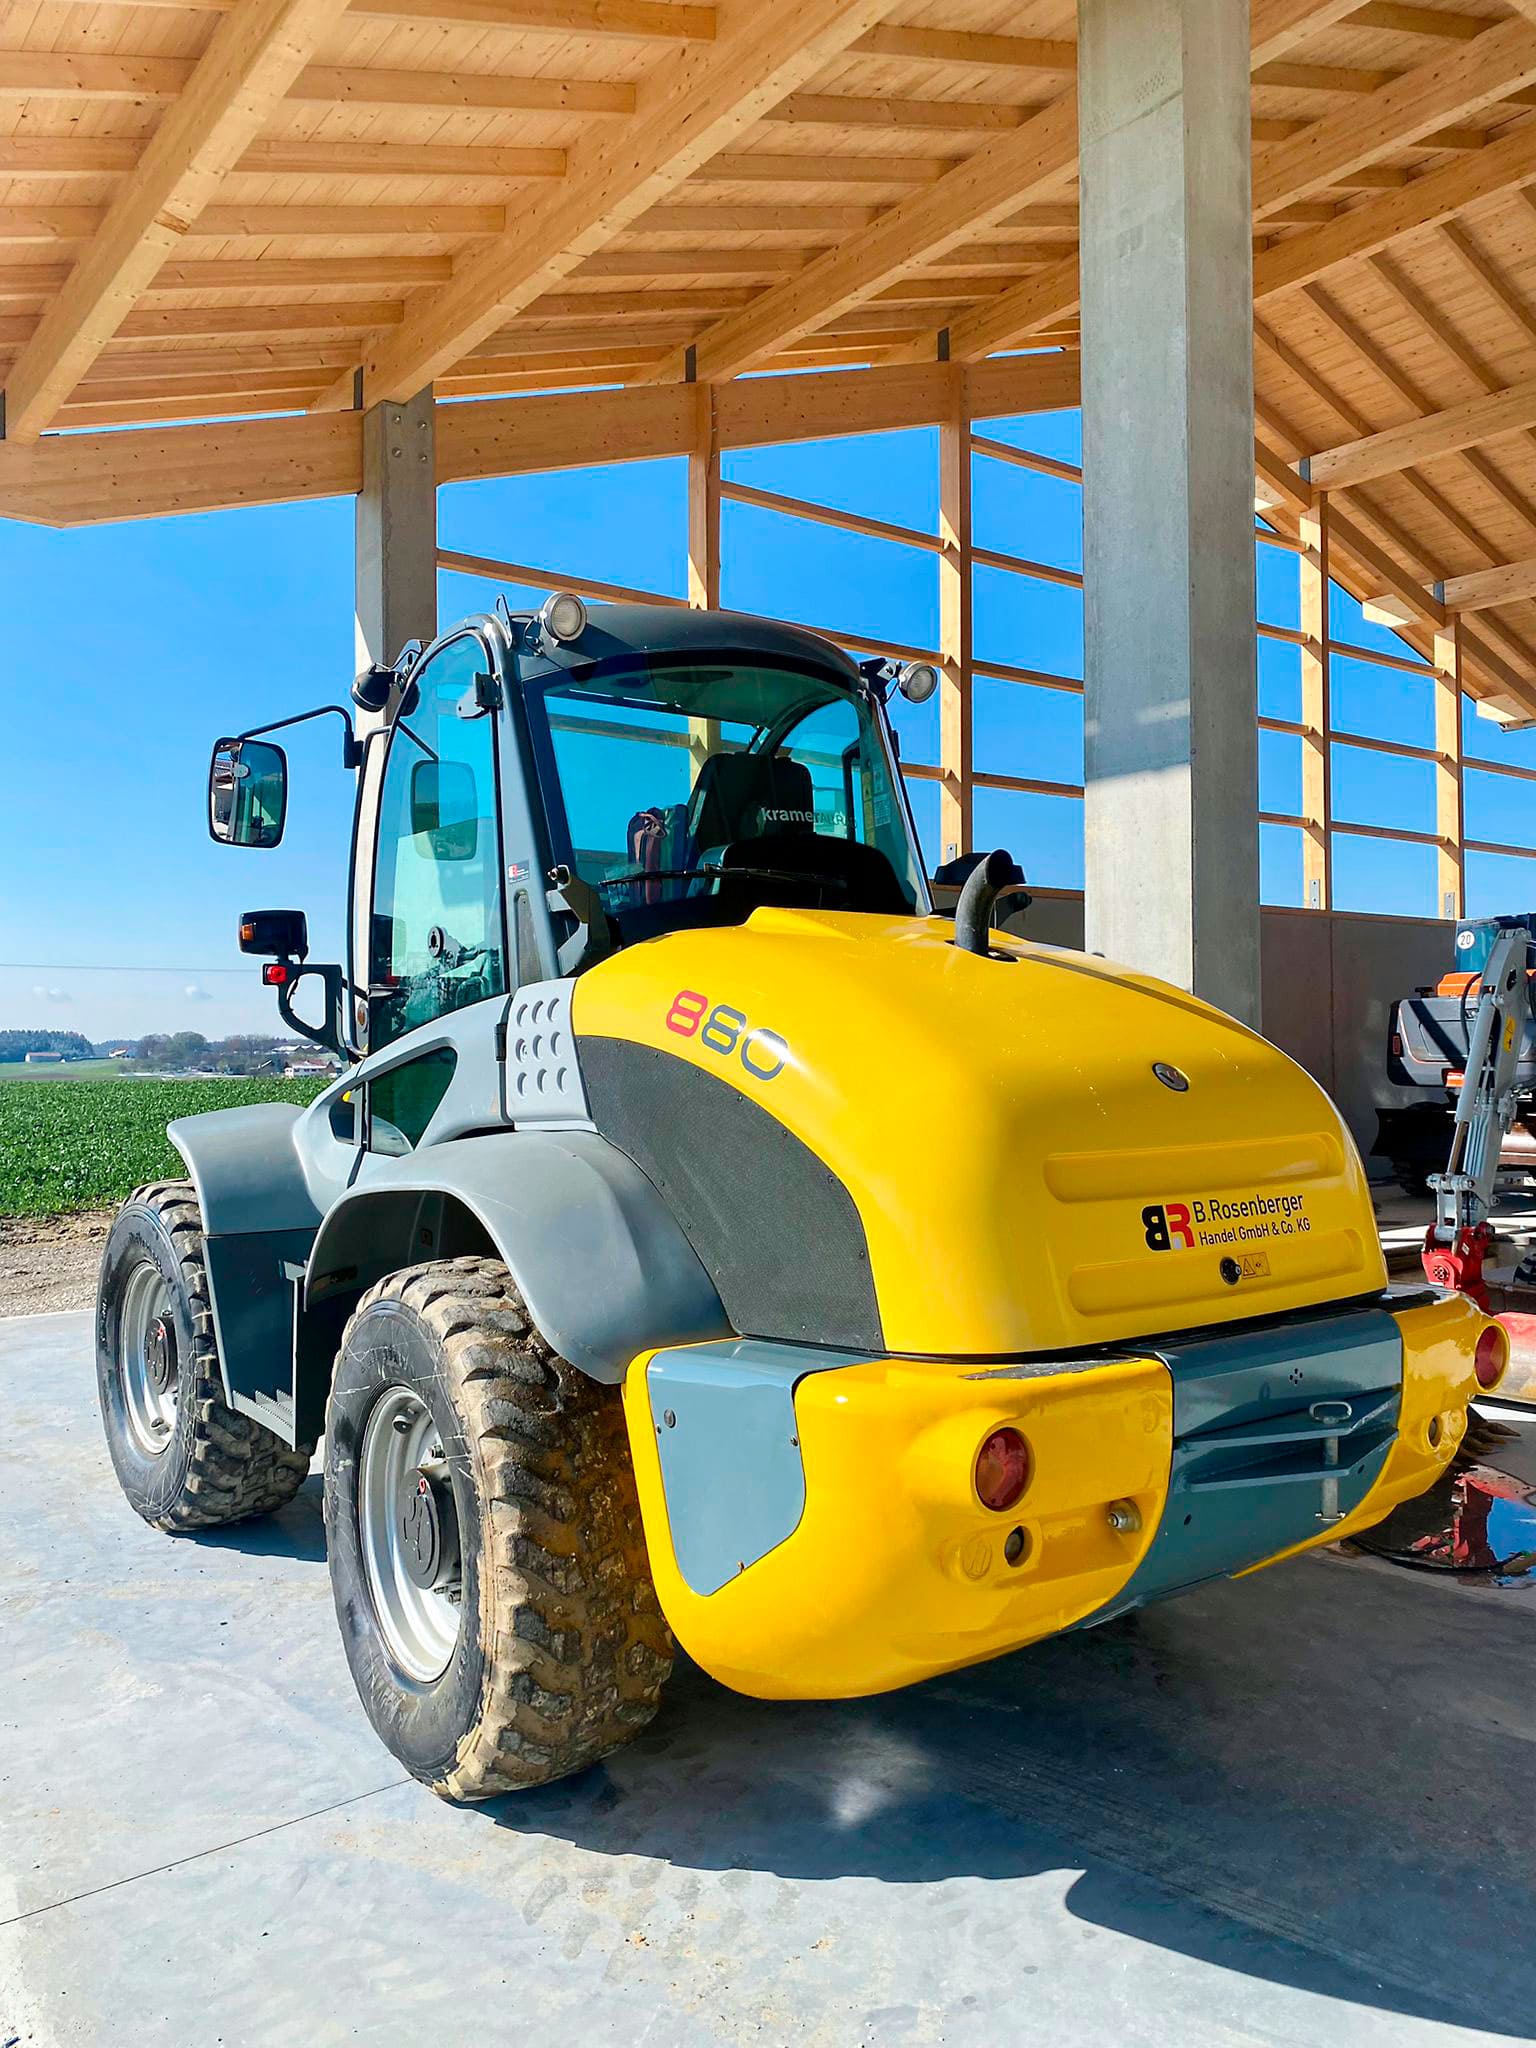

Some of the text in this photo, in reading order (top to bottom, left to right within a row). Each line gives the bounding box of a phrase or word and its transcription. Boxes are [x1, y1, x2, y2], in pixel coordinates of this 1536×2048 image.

[1460, 934, 1471, 946] 20
[666, 990, 788, 1080] 880
[1192, 1194, 1304, 1223] B.Rosenberger
[1199, 1217, 1311, 1246] Handel GmbH & Co. KG
